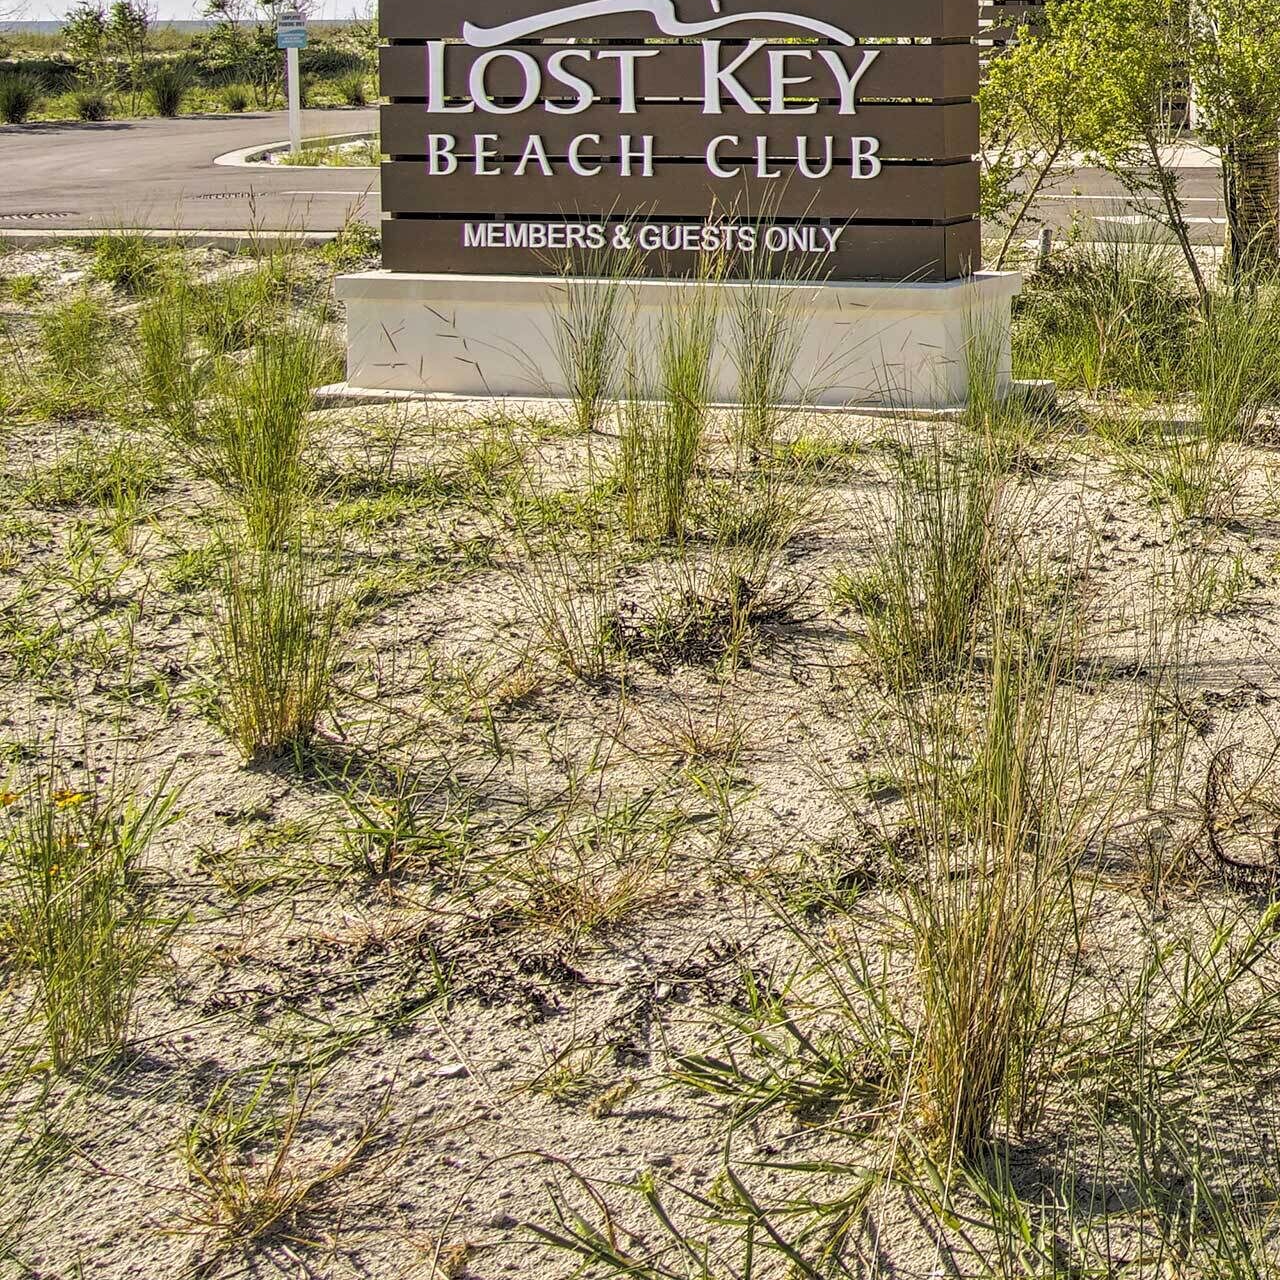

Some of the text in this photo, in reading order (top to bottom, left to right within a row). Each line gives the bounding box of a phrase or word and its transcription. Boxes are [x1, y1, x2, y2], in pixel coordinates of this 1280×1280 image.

[426, 39, 881, 116] LOST KEY
[427, 133, 883, 180] BEACH CLUB
[463, 222, 844, 254] MEMBERS & GUESTS ONLY
